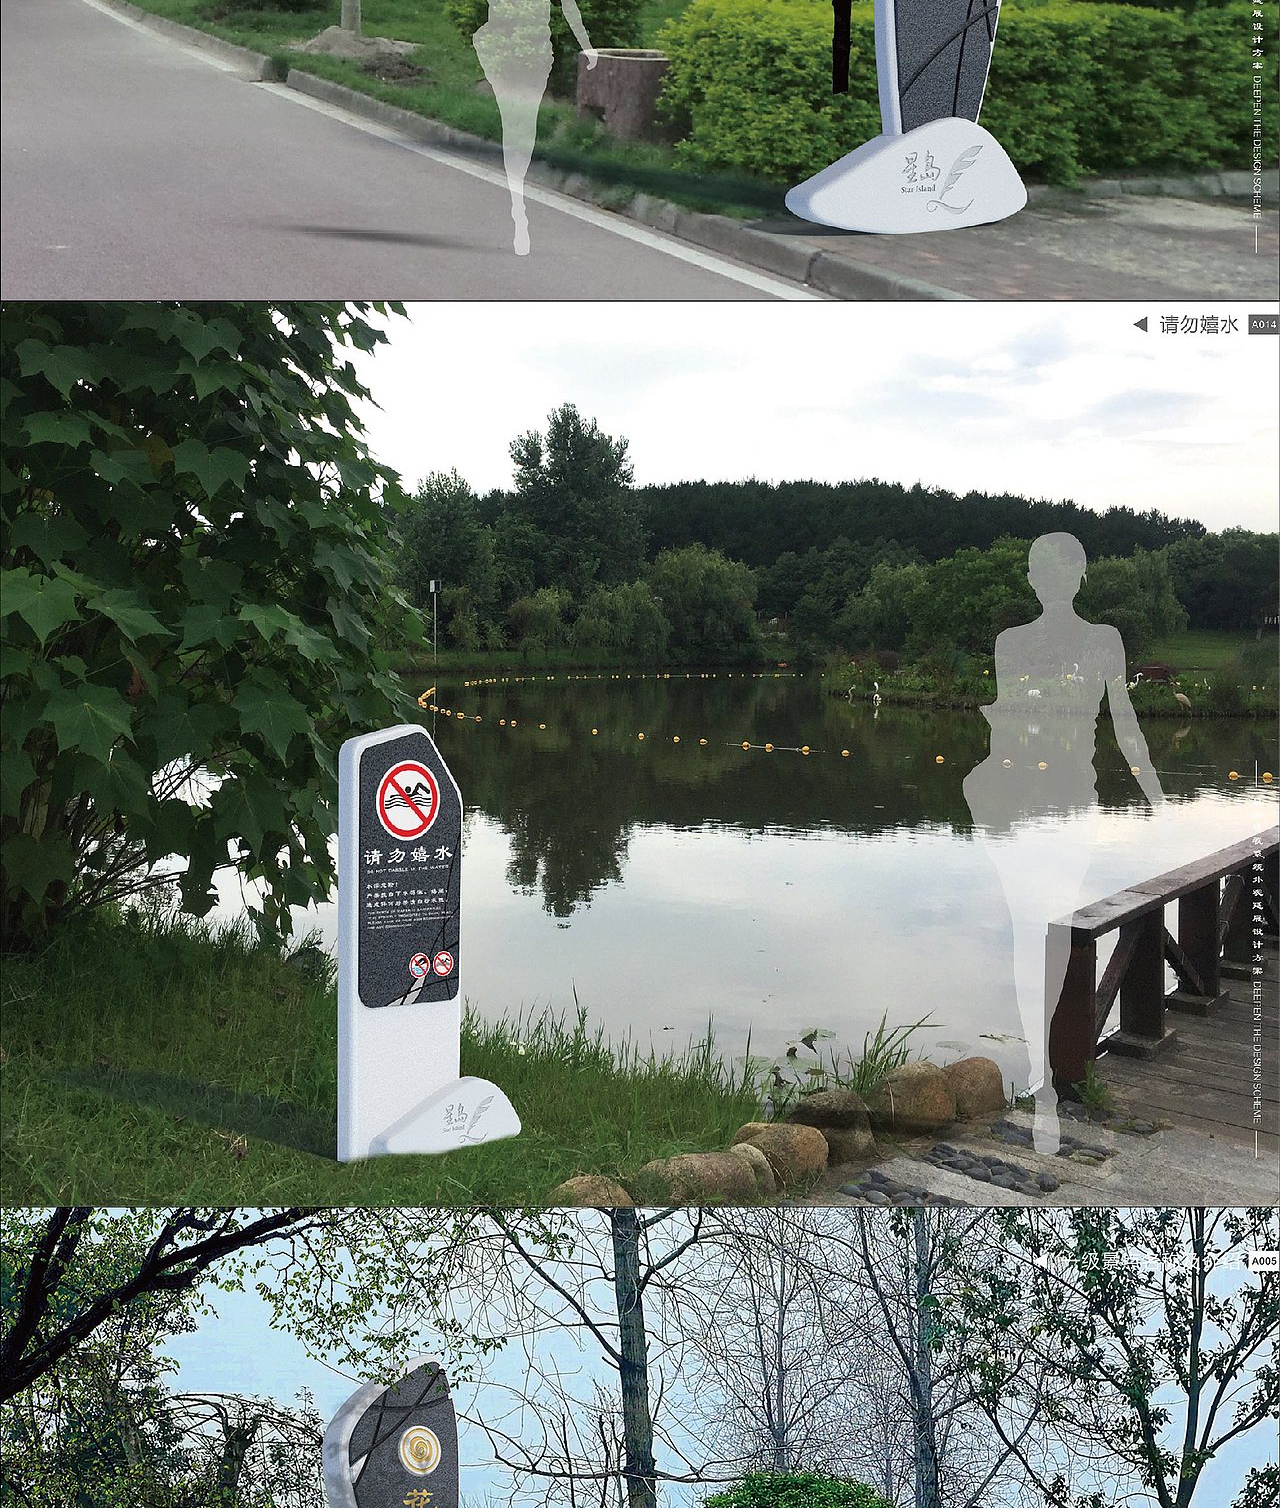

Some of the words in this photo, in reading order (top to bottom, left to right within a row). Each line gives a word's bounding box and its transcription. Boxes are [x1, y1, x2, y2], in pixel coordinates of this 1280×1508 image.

[915, 184, 936, 192] Island
[364, 845, 453, 865] 请勿嬉水
